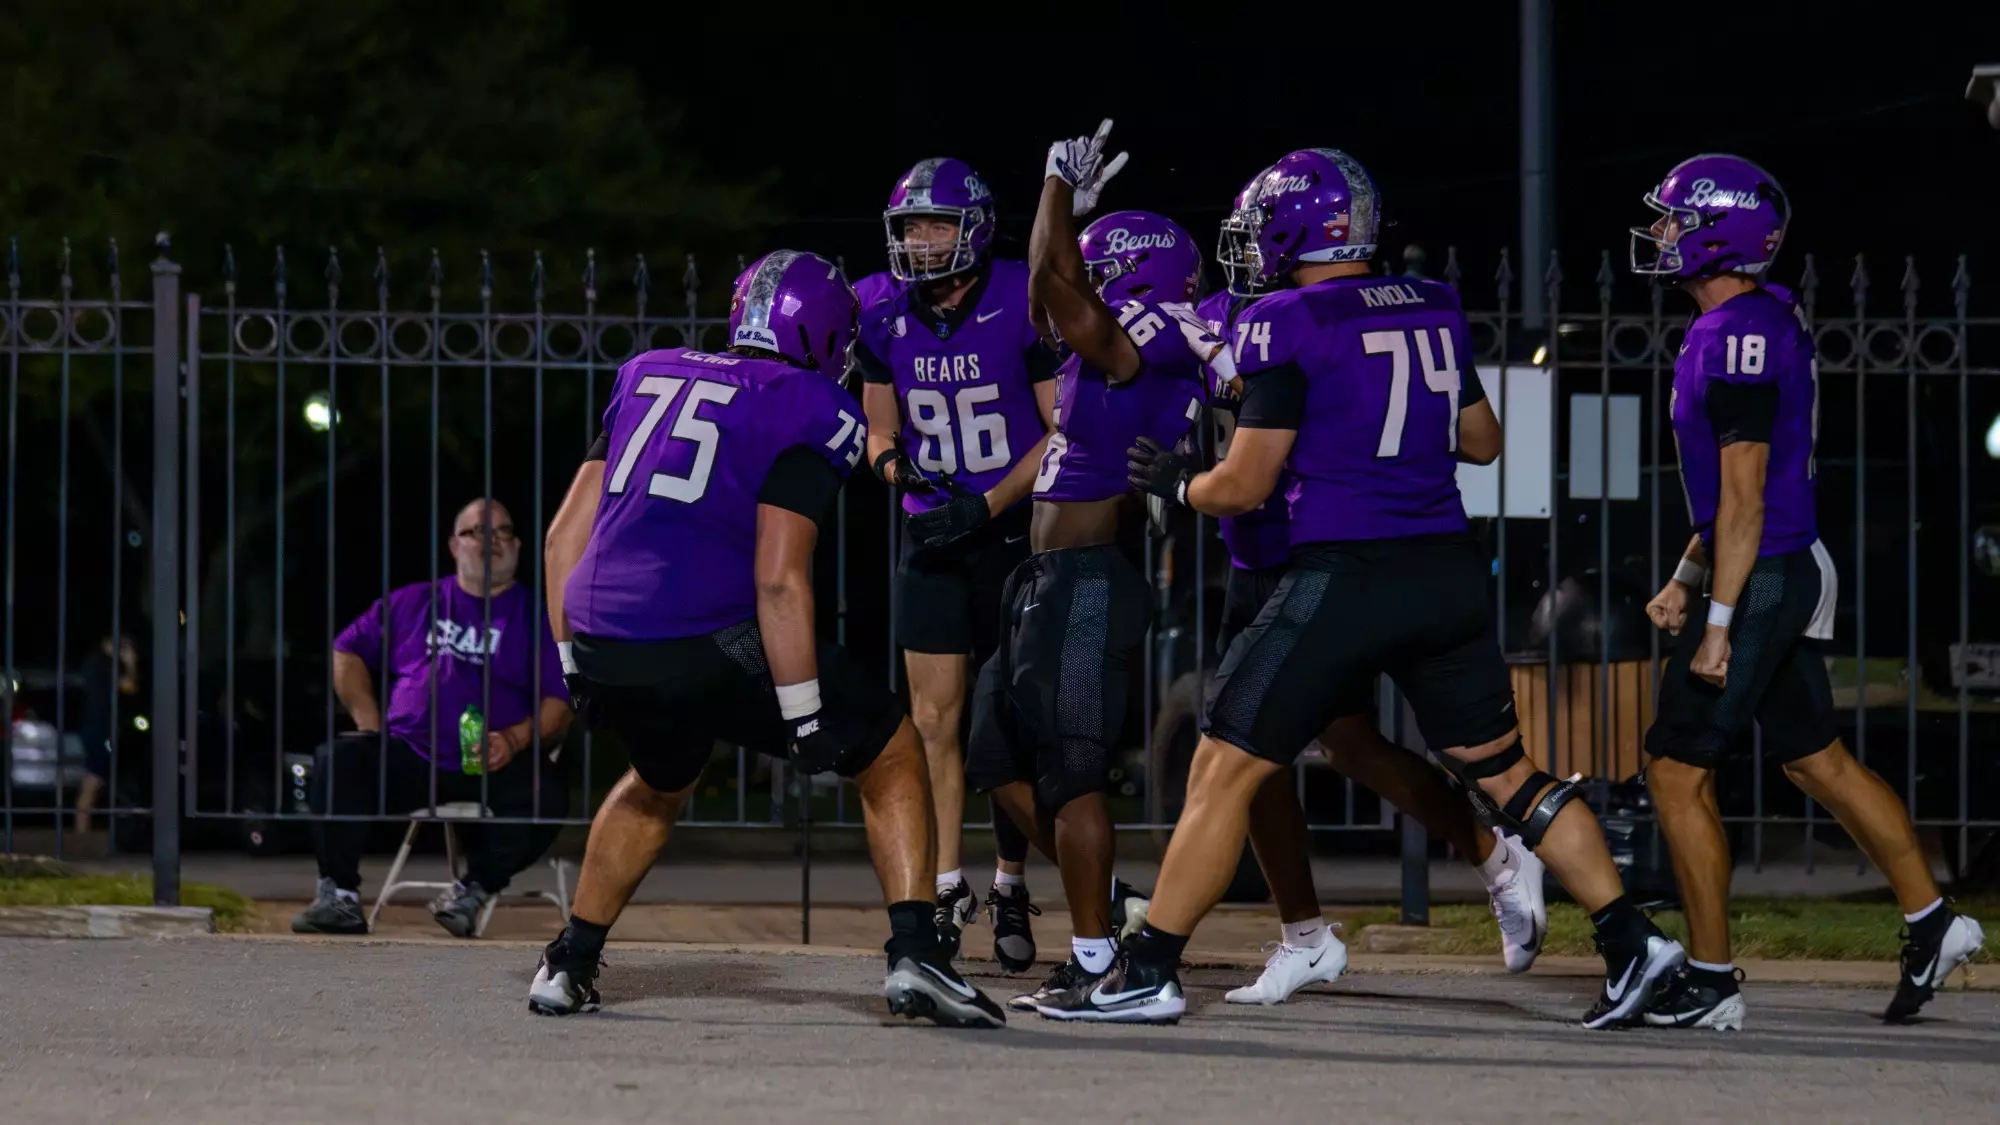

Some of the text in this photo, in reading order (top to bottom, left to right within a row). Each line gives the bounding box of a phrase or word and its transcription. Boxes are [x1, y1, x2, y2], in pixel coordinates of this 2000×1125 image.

[1684, 178, 1760, 210] Bears
[1103, 228, 1177, 256] Bears
[1358, 284, 1425, 308] KNOLL
[1236, 321, 1271, 364] 74
[1726, 334, 1766, 375] 18
[914, 353, 981, 383] BEARS
[1361, 327, 1461, 458] 74
[608, 373, 741, 504] 75
[825, 409, 866, 469] 75
[906, 382, 1012, 475] 86
[796, 718, 820, 738] NIKE
